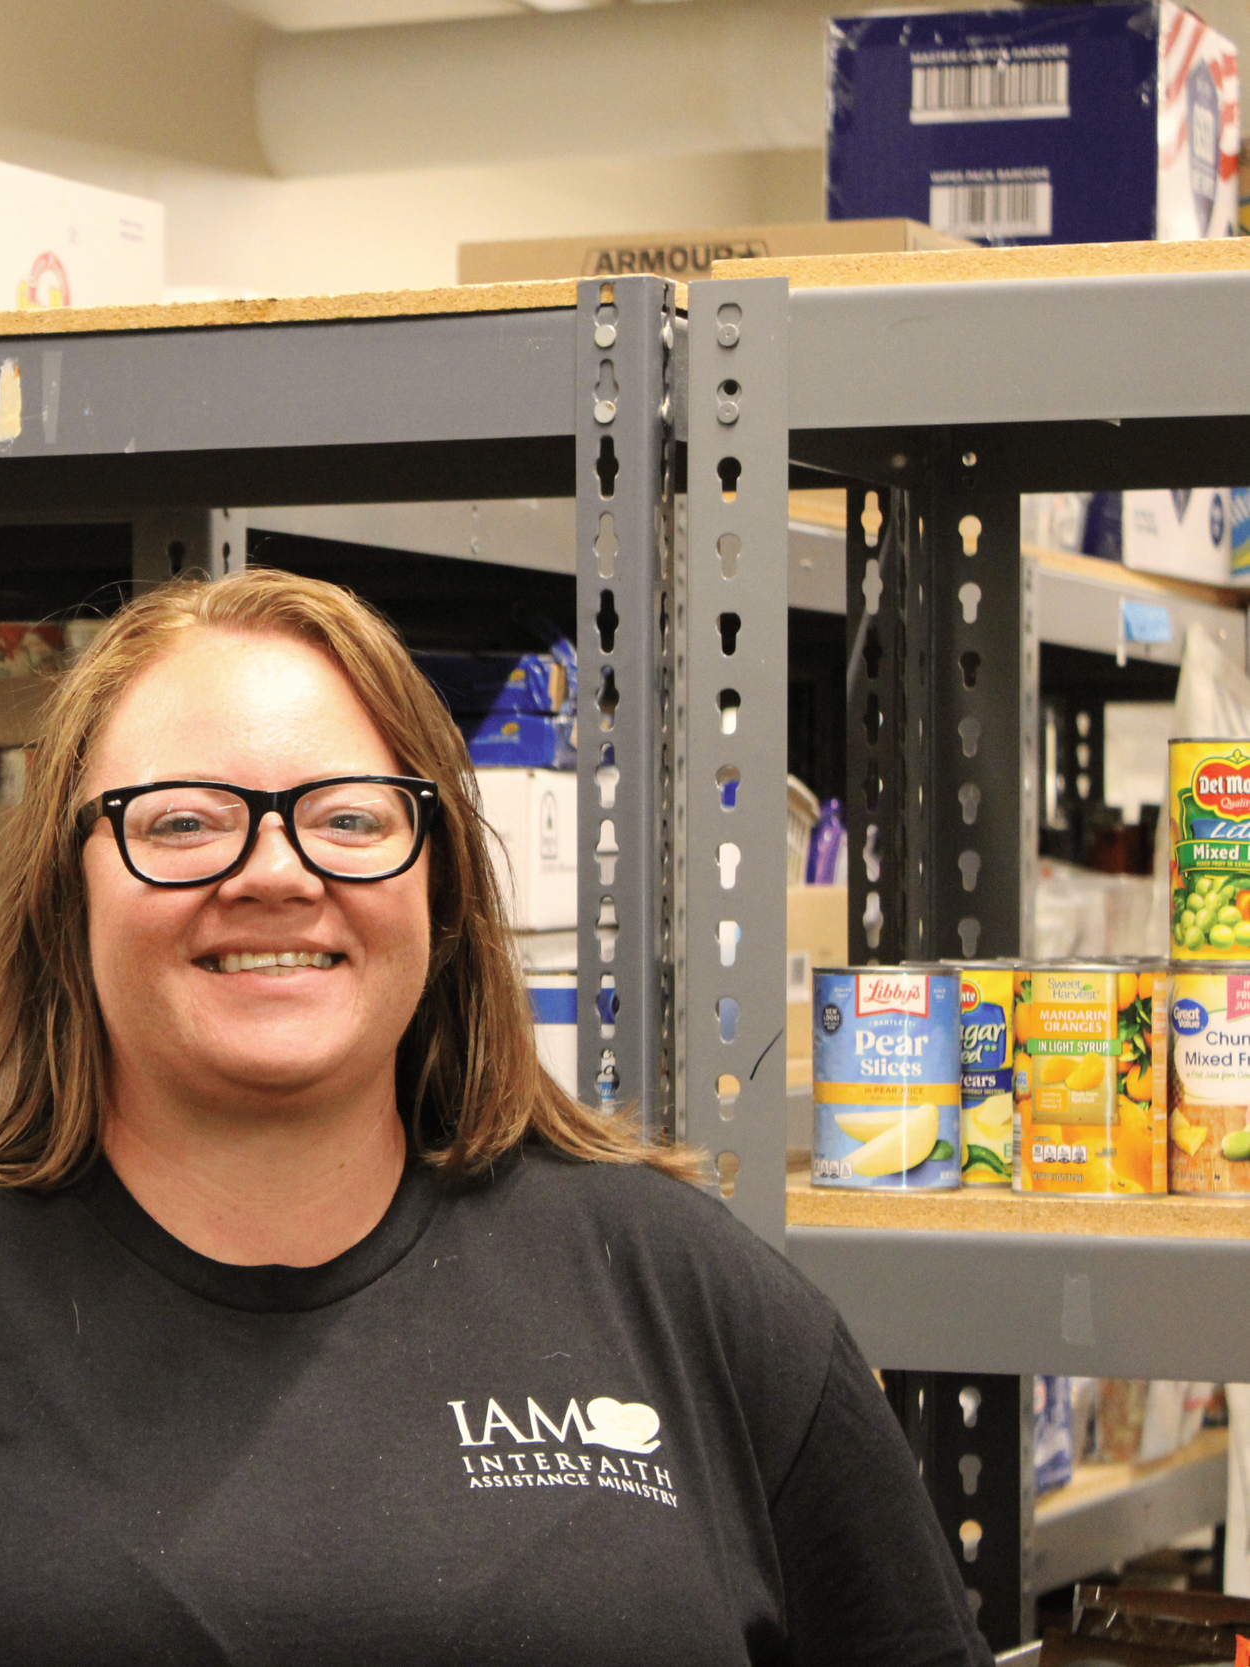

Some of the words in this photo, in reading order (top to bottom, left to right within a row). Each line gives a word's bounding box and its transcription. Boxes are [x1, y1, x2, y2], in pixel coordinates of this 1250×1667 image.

[1198, 775, 1225, 795] Del
[1210, 821, 1250, 839] Lit
[1193, 843, 1240, 860] Mixed
[1048, 978, 1081, 990] Sweet
[863, 979, 920, 1005] Libby's
[961, 991, 976, 1002] nte
[1052, 988, 1098, 1000] Harvest
[1236, 991, 1250, 1000] FRU
[1173, 1006, 1200, 1021] Great
[1235, 1002, 1250, 1011] JUI
[1040, 1010, 1107, 1021] MANDARIN
[1044, 1021, 1103, 1033] ORANGES
[1178, 1018, 1201, 1029] Value
[855, 1030, 929, 1056] Pear
[960, 1023, 1006, 1049] gar
[1206, 1031, 1250, 1046] Chun
[1038, 1040, 1047, 1051] IN
[1049, 1041, 1075, 1052] LIGHT
[1077, 1041, 1109, 1053] SYRUP
[860, 1057, 922, 1076] Slices
[1185, 1052, 1233, 1066] Mixed
[447, 1396, 592, 1446] IAM
[462, 1452, 673, 1489] INTERFAITH
[470, 1474, 590, 1489] ASSISTANCE
[597, 1475, 678, 1508] MINISTRY
